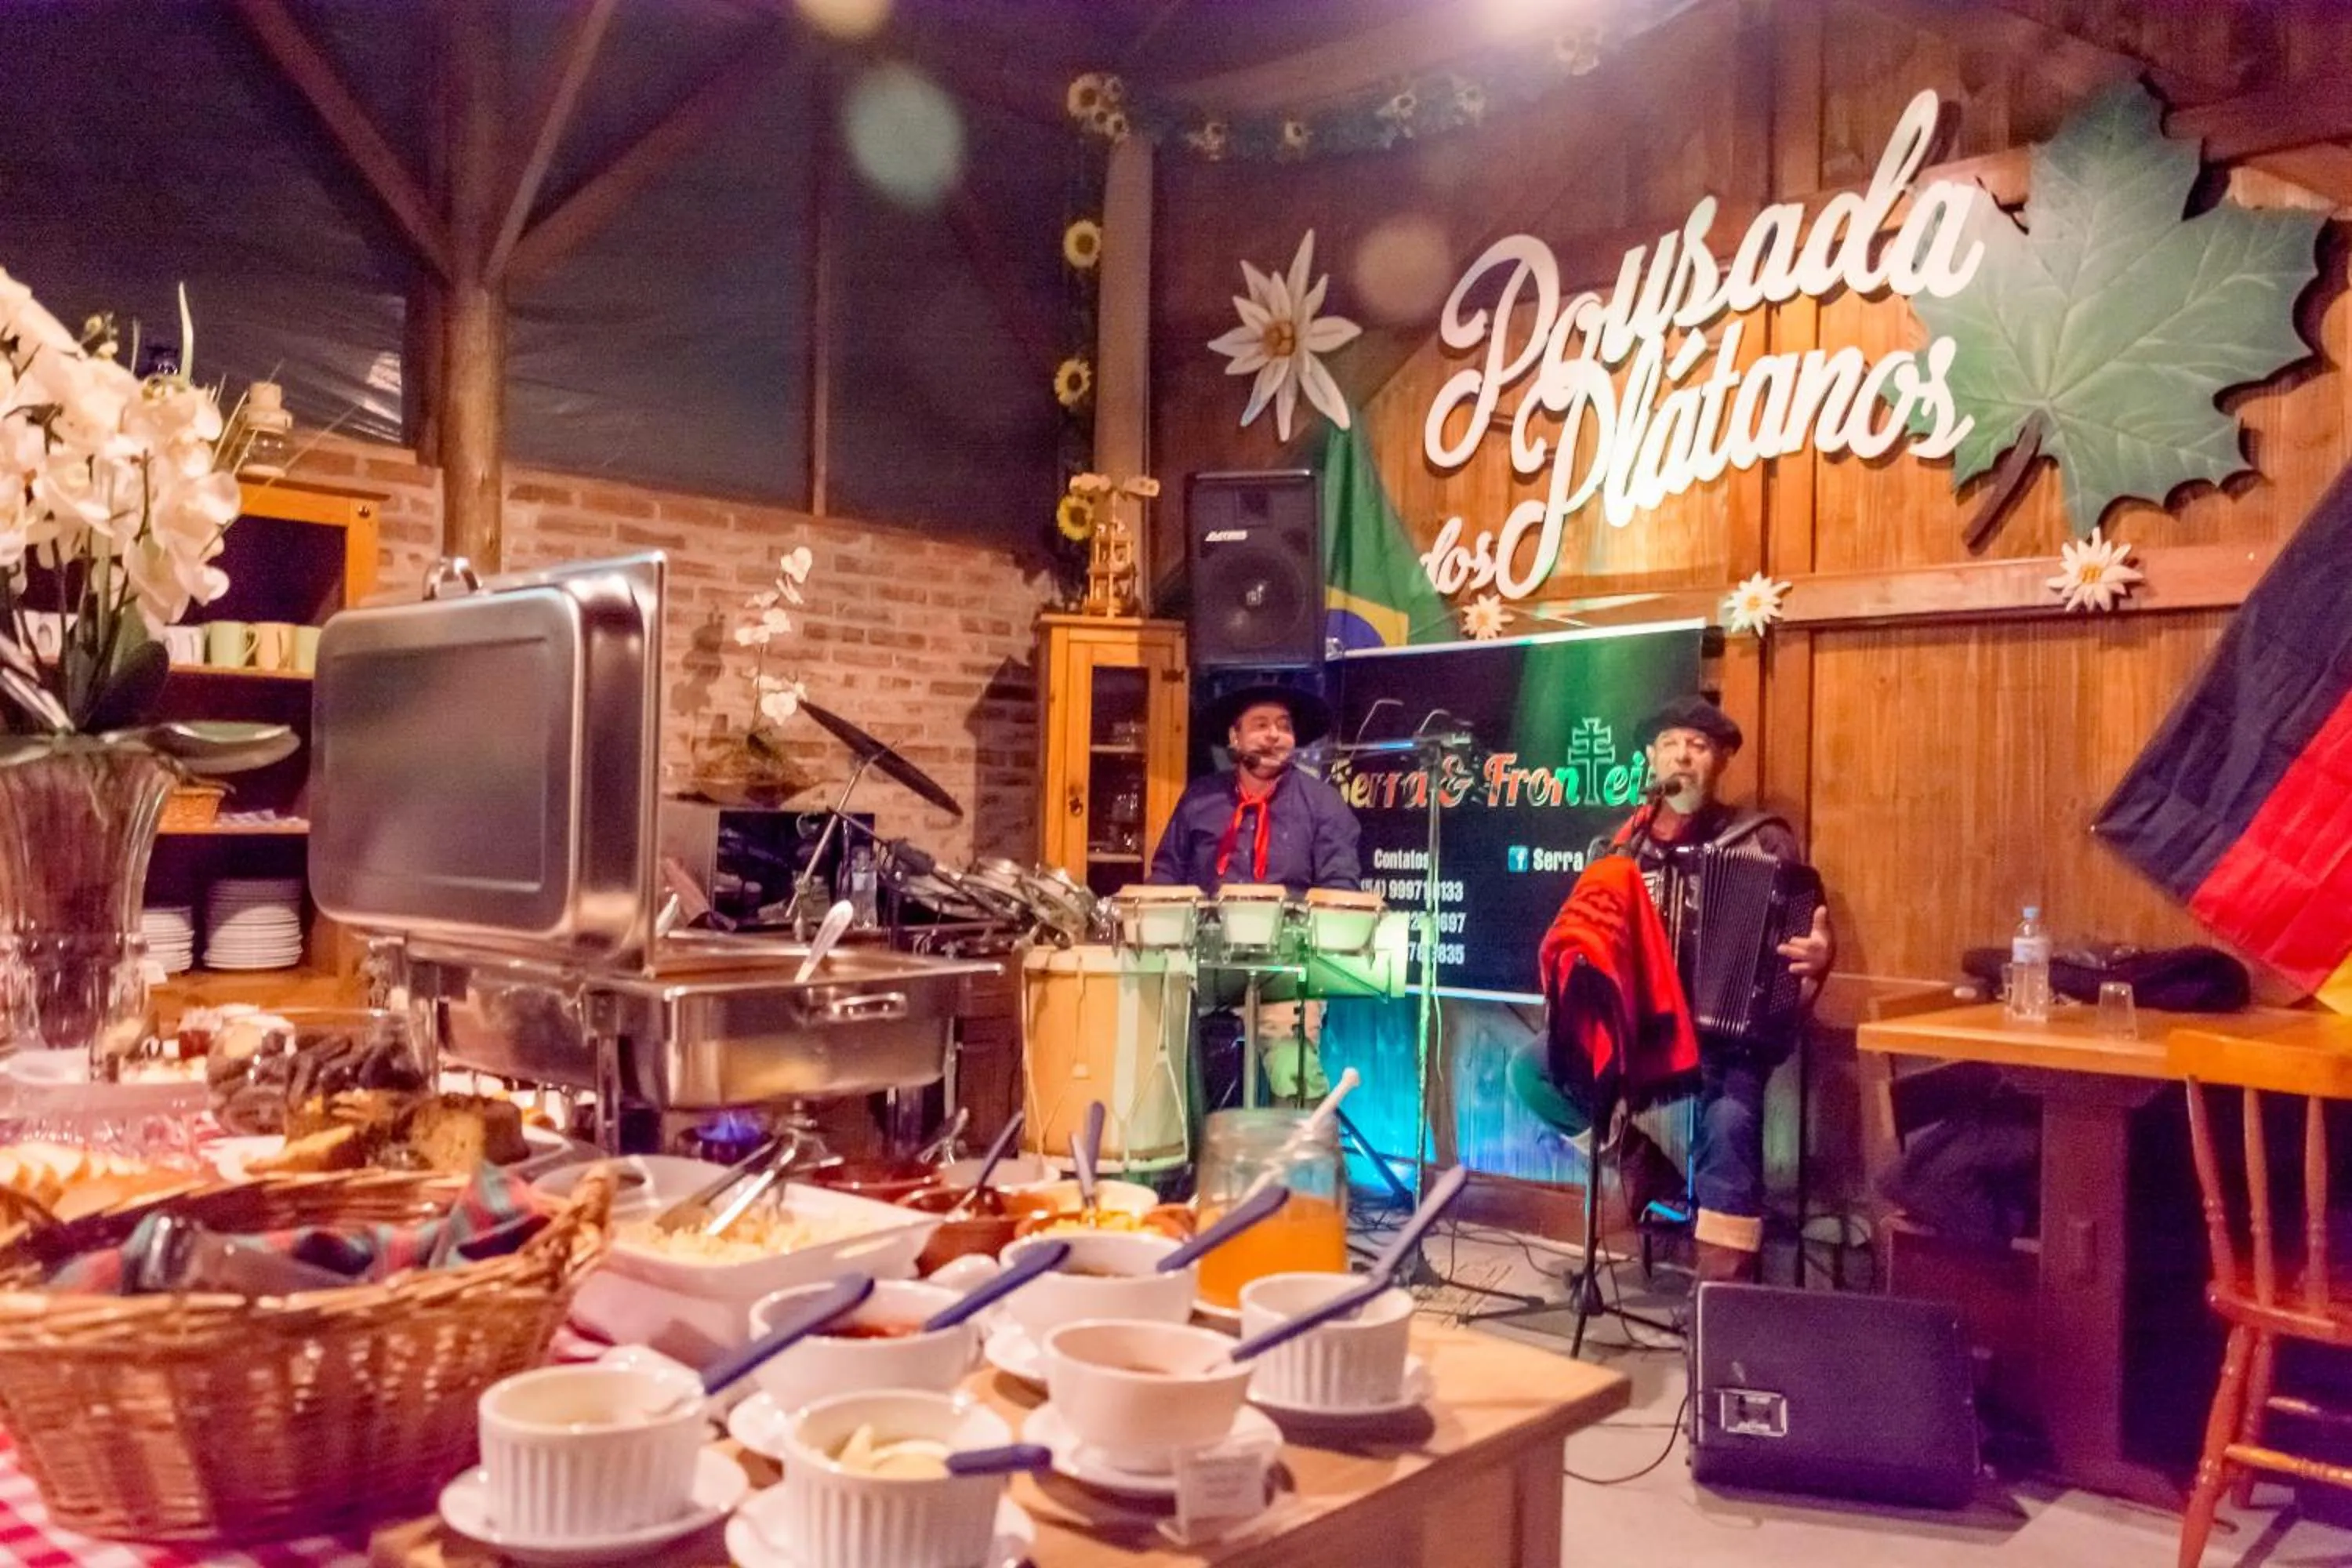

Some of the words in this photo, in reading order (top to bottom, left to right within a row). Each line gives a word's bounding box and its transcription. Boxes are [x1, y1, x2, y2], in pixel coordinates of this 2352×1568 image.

[1425, 89, 1985, 470] Pousada
[1419, 516, 1497, 595] los
[1494, 318, 1976, 600] Plátanos
[1374, 848, 1431, 869] Contatos
[1533, 847, 1584, 872] Serra
